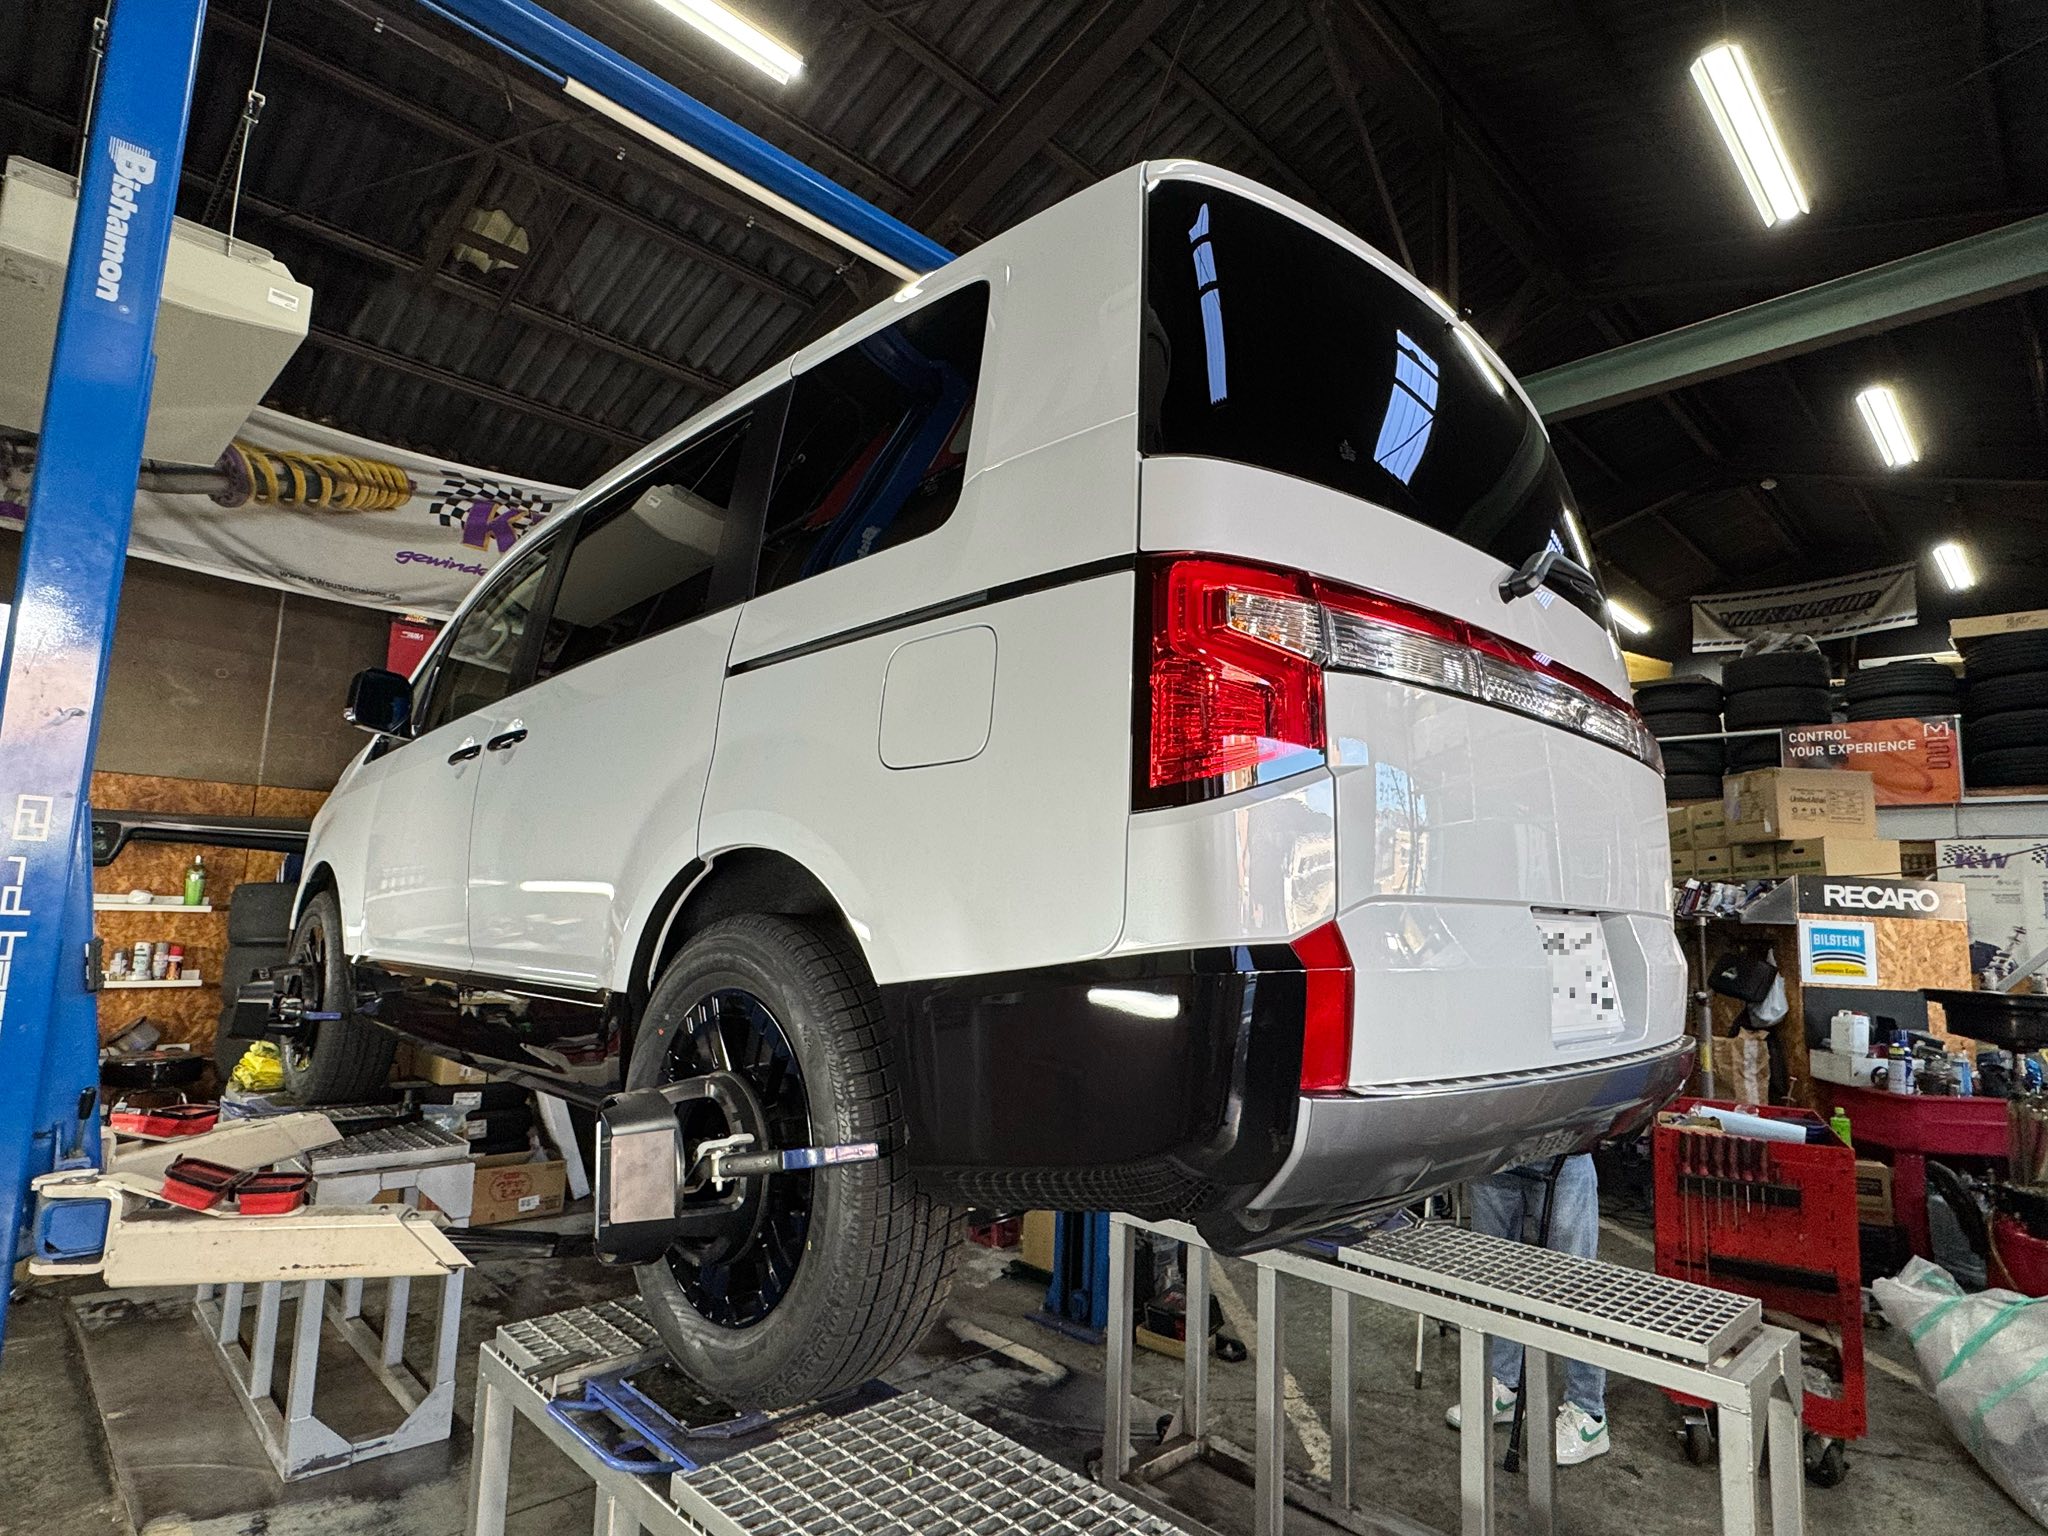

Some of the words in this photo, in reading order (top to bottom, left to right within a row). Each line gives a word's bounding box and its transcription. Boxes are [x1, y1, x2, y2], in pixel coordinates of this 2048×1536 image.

[95, 136, 157, 302] Bishamon
[463, 500, 547, 553] K
[1788, 729, 1851, 743] CONTROL
[1789, 745, 1825, 758] YOUR
[1828, 739, 1917, 755] EXPERIENCE
[1955, 852, 2009, 869] KW
[1823, 884, 1940, 912] RECARO
[1813, 933, 1861, 947] BILSTEIN
